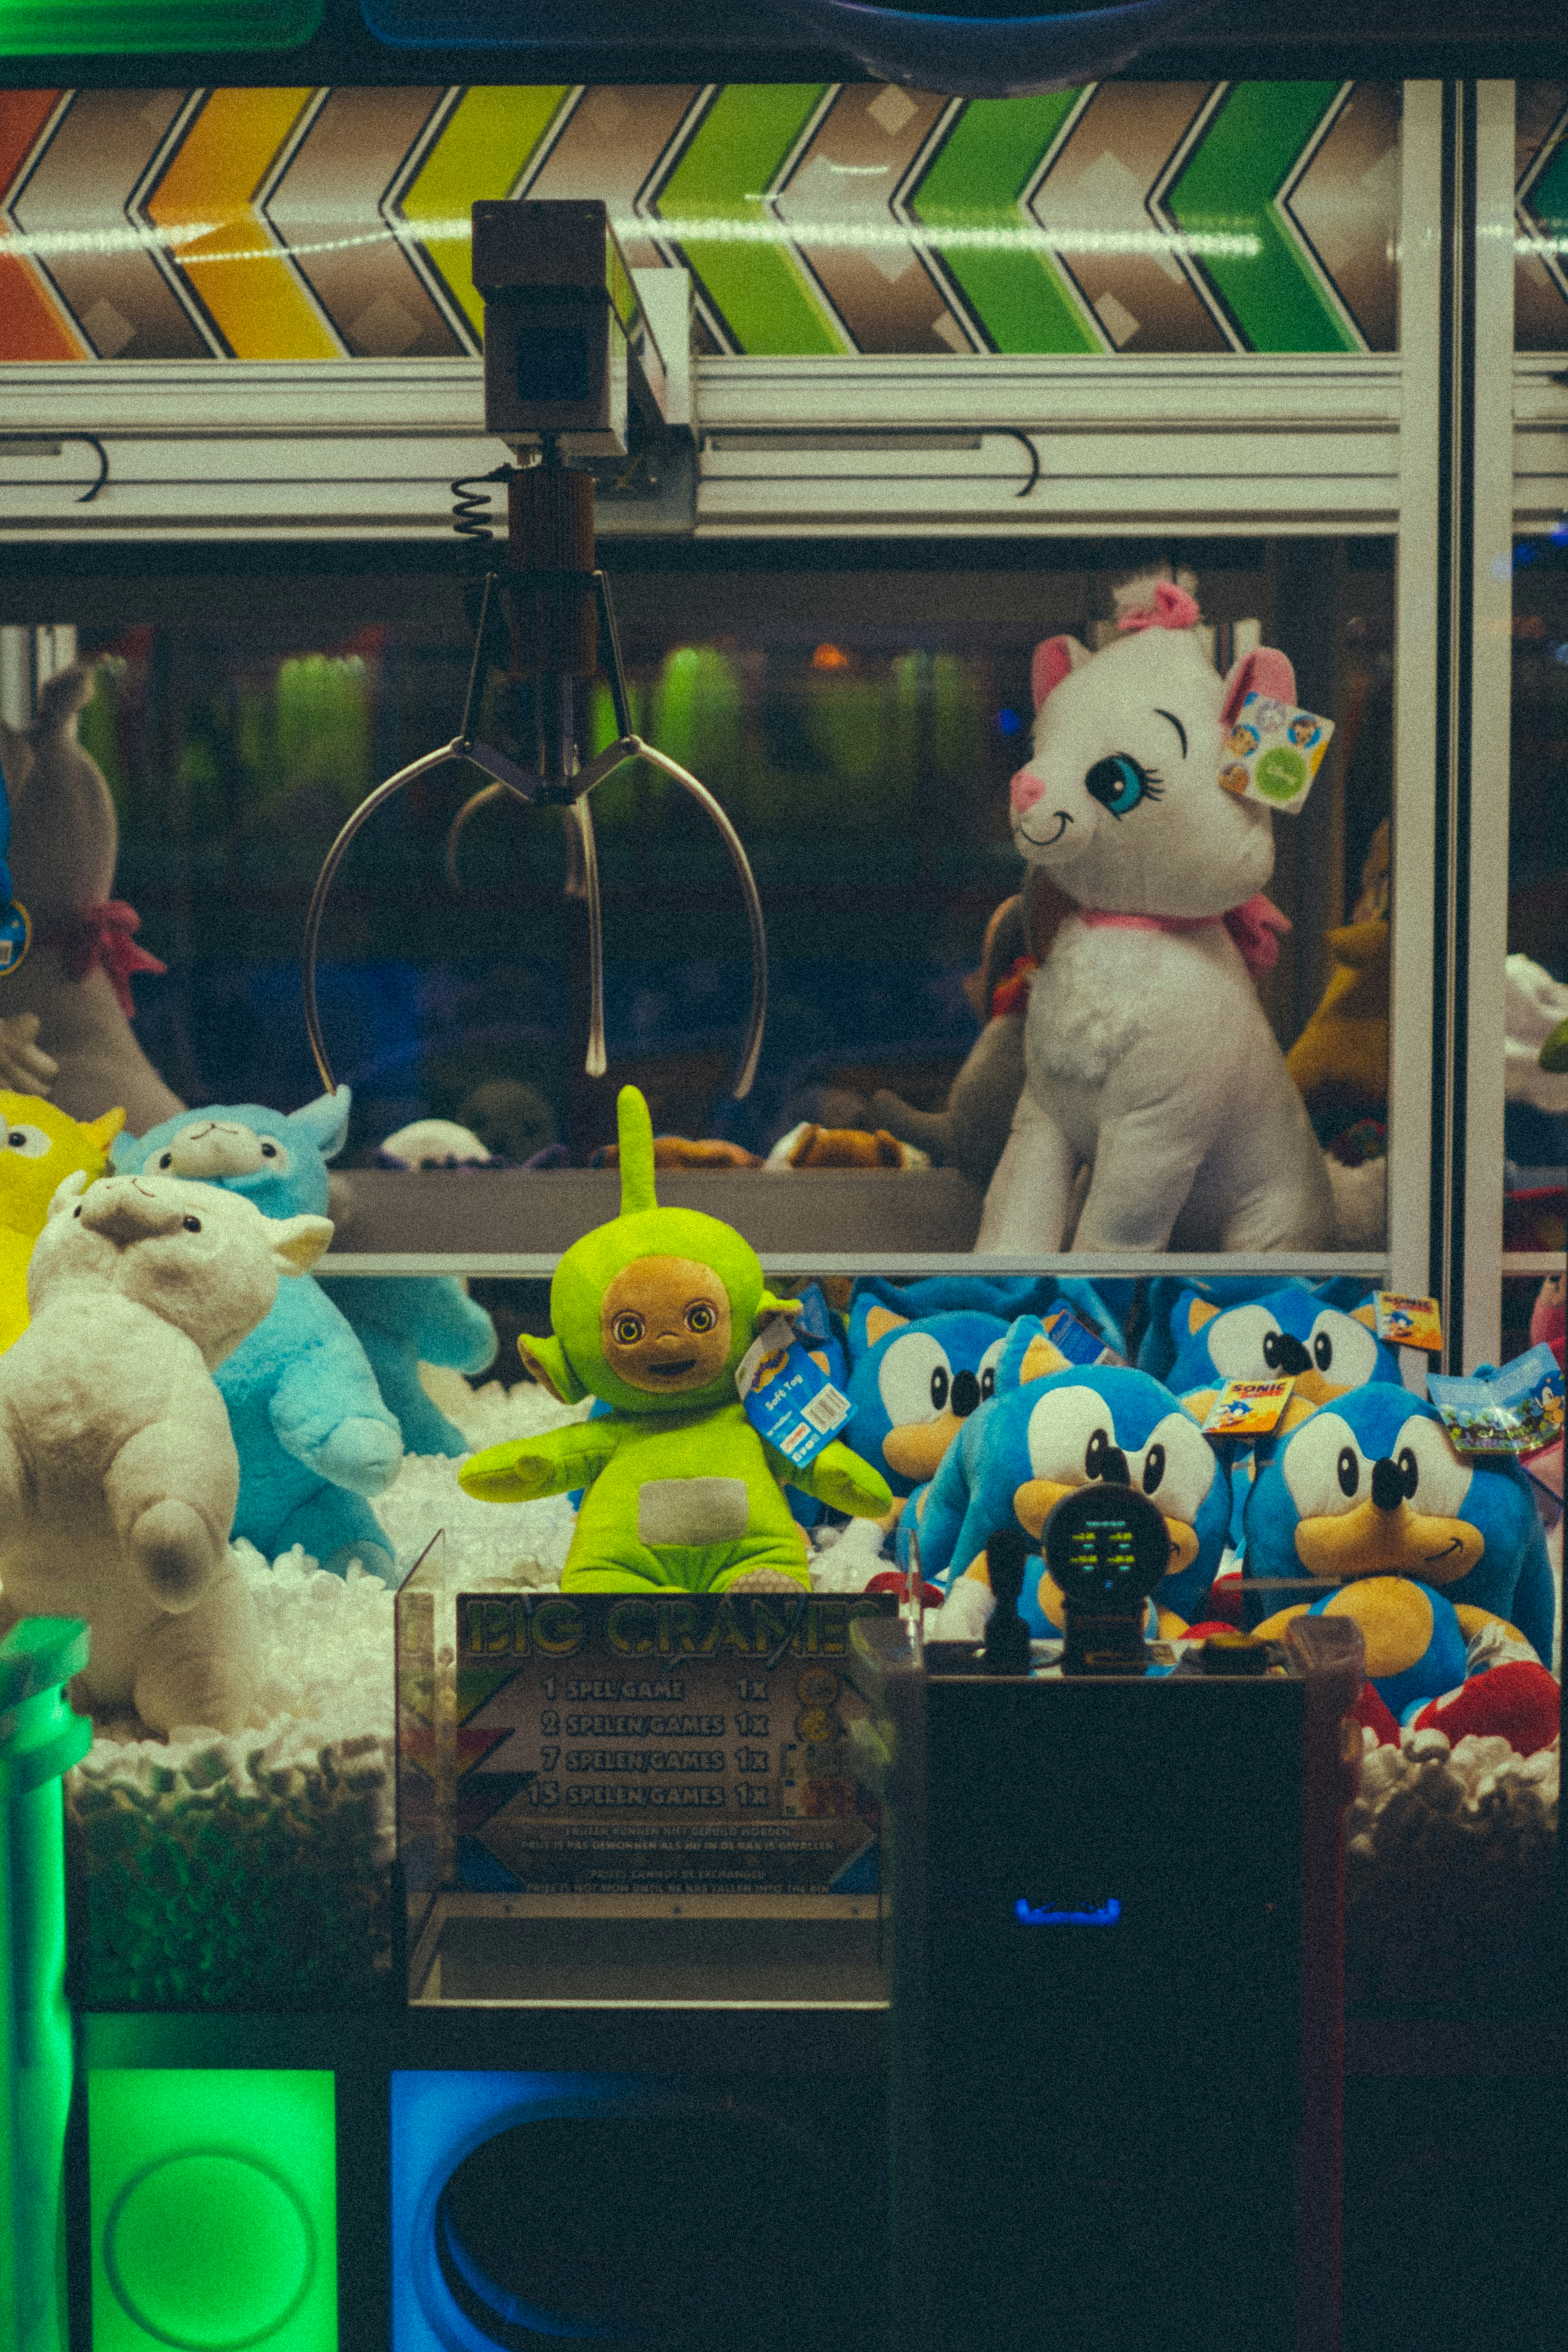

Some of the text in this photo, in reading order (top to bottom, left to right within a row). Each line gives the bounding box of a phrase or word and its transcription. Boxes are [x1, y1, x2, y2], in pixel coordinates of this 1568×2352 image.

[765, 1389, 787, 1411] Soft
[783, 1374, 803, 1390] Toy
[1232, 1381, 1288, 1392] SONIC
[466, 1600, 881, 1658] BIG CRANE
[542, 1677, 557, 1699] 1
[567, 1680, 684, 1700] SPEL/GAME
[542, 1711, 559, 1735] 2
[567, 1716, 724, 1736] SPELEN/GAMES
[542, 1747, 559, 1770] 7
[567, 1752, 724, 1772] SPELEN/GAMES
[529, 1782, 559, 1805] 15
[567, 1787, 724, 1807] SPELEN/GAMES
